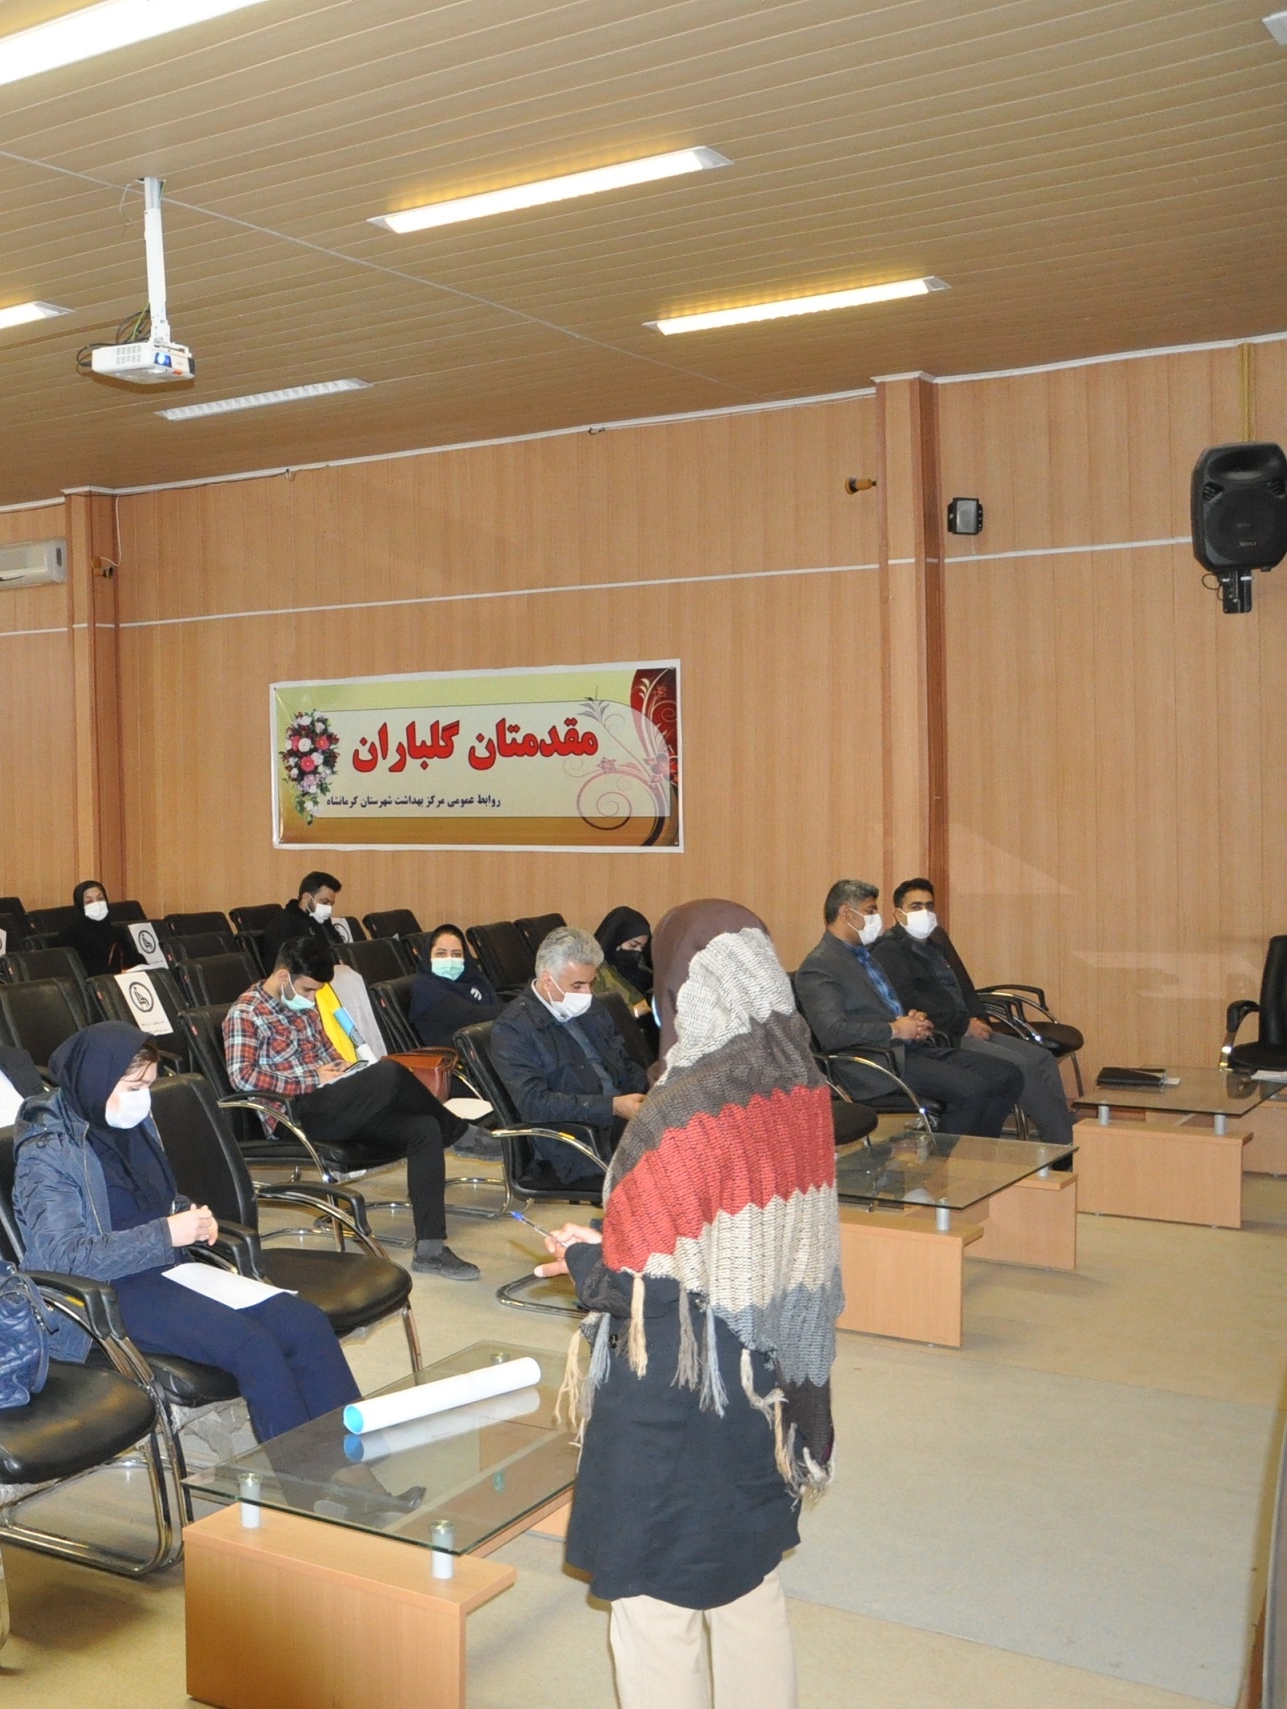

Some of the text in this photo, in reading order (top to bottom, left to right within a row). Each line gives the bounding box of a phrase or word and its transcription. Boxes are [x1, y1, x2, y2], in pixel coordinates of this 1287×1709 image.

[352, 717, 599, 773] مقدمتان گلباران
[326, 794, 501, 809] روابط عمومی مرکز بهداشت شهرستان کرمانشاه
